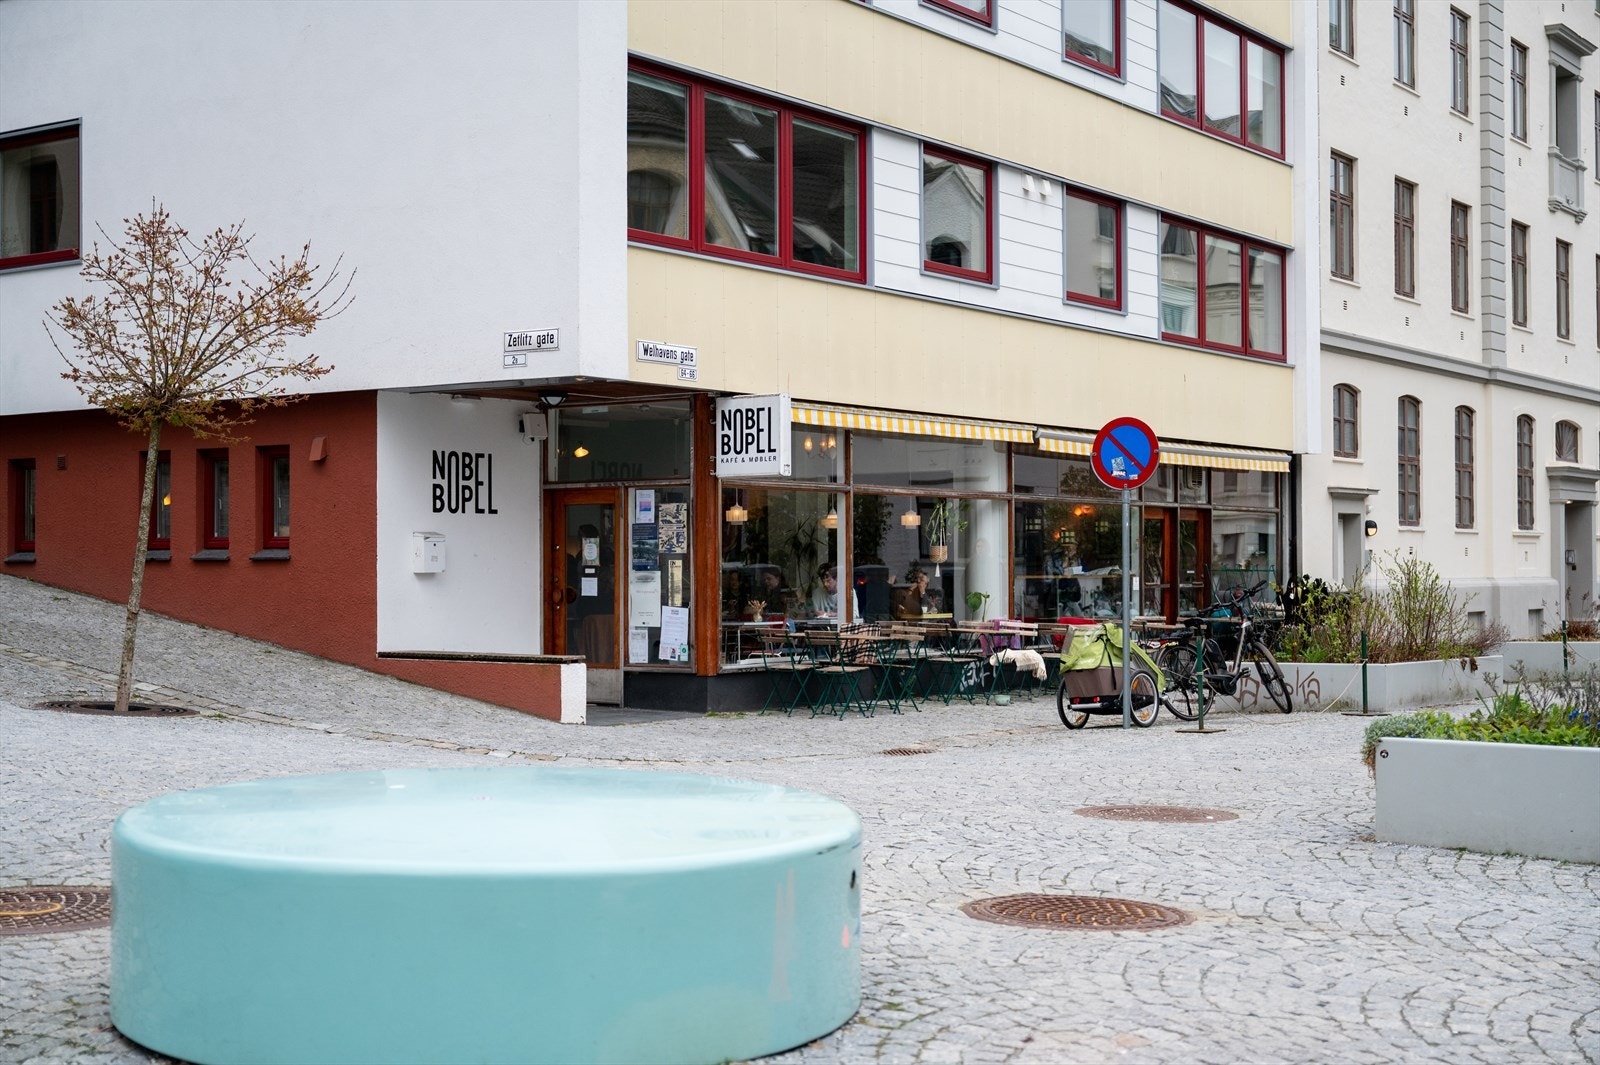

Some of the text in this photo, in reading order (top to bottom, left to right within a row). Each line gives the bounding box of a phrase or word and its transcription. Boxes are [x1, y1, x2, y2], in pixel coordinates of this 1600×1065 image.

[508, 332, 554, 347] Zetlitz gate
[642, 343, 694, 363] Welhavens gate
